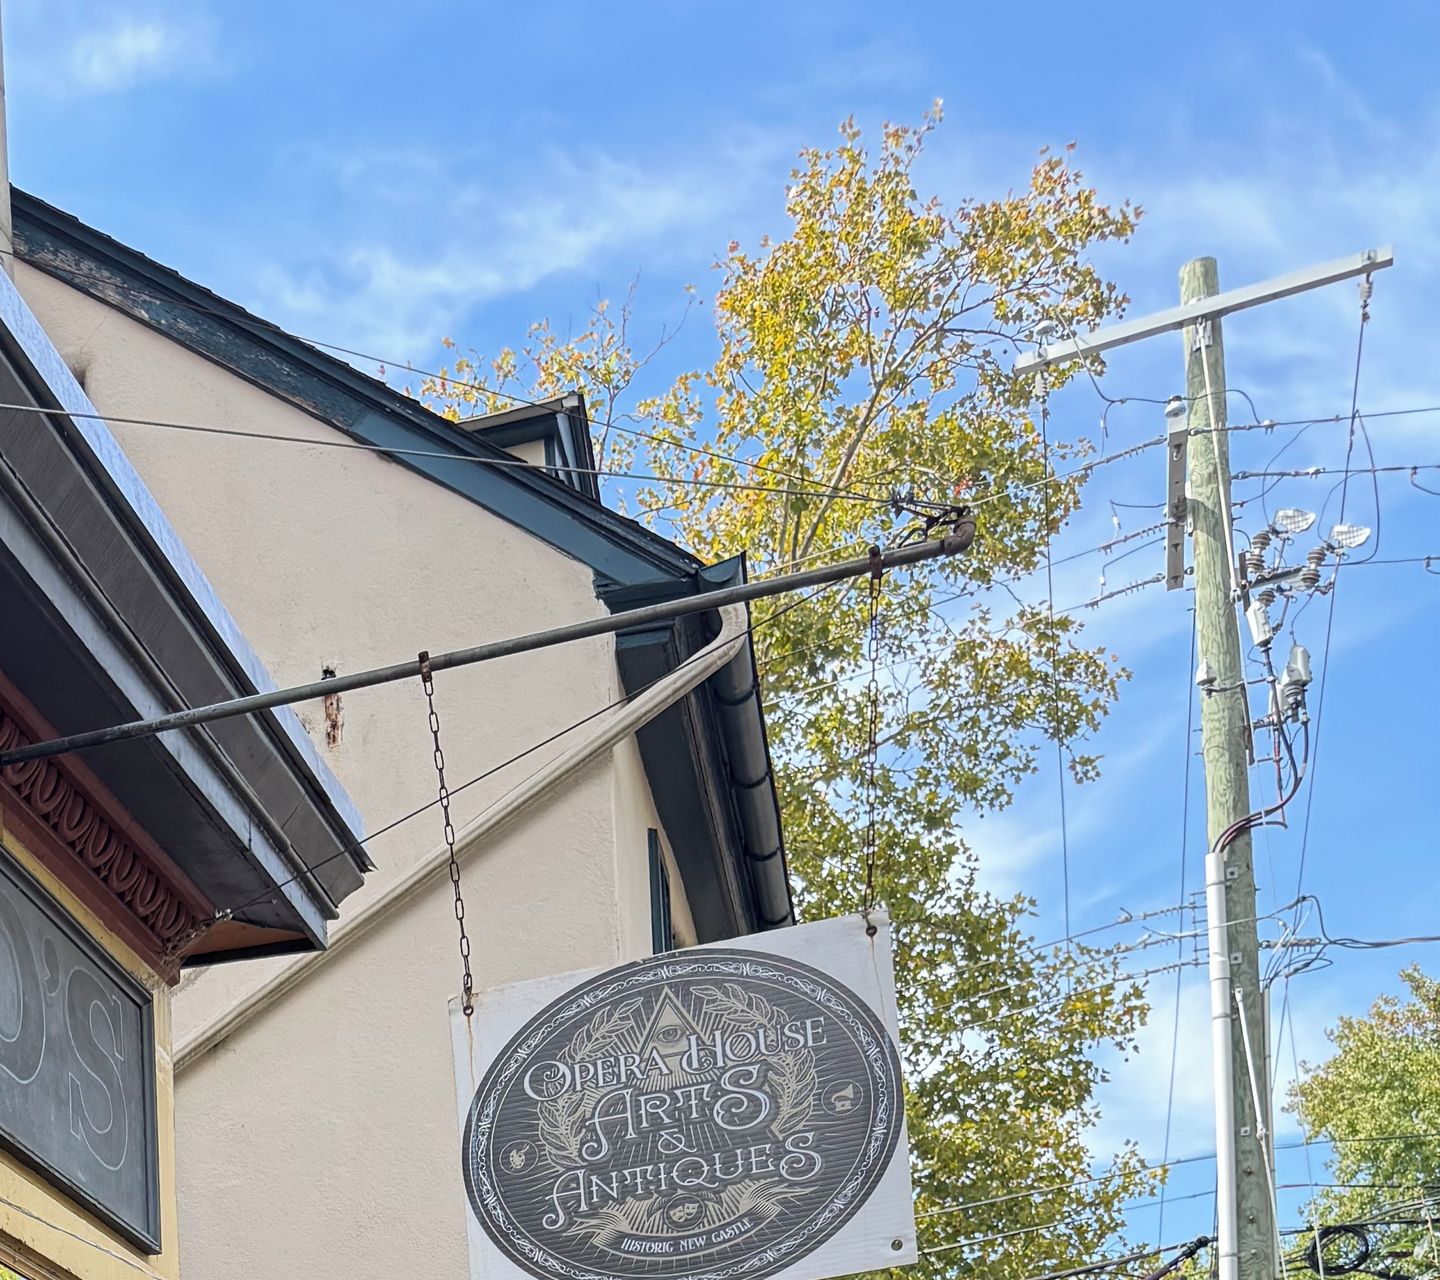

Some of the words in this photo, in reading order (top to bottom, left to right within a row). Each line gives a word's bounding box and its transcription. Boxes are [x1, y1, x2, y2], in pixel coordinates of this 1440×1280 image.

[523, 1054, 673, 1102] OPERA
[681, 1016, 829, 1075] HOUSE
[582, 1064, 771, 1161] ARTS
[658, 1130, 698, 1154] &
[542, 1132, 824, 1230] ANTIQUES
[621, 1237, 675, 1254] HISTORIC
[679, 1235, 707, 1252] NEW
[711, 1217, 755, 1243] CASTLE
